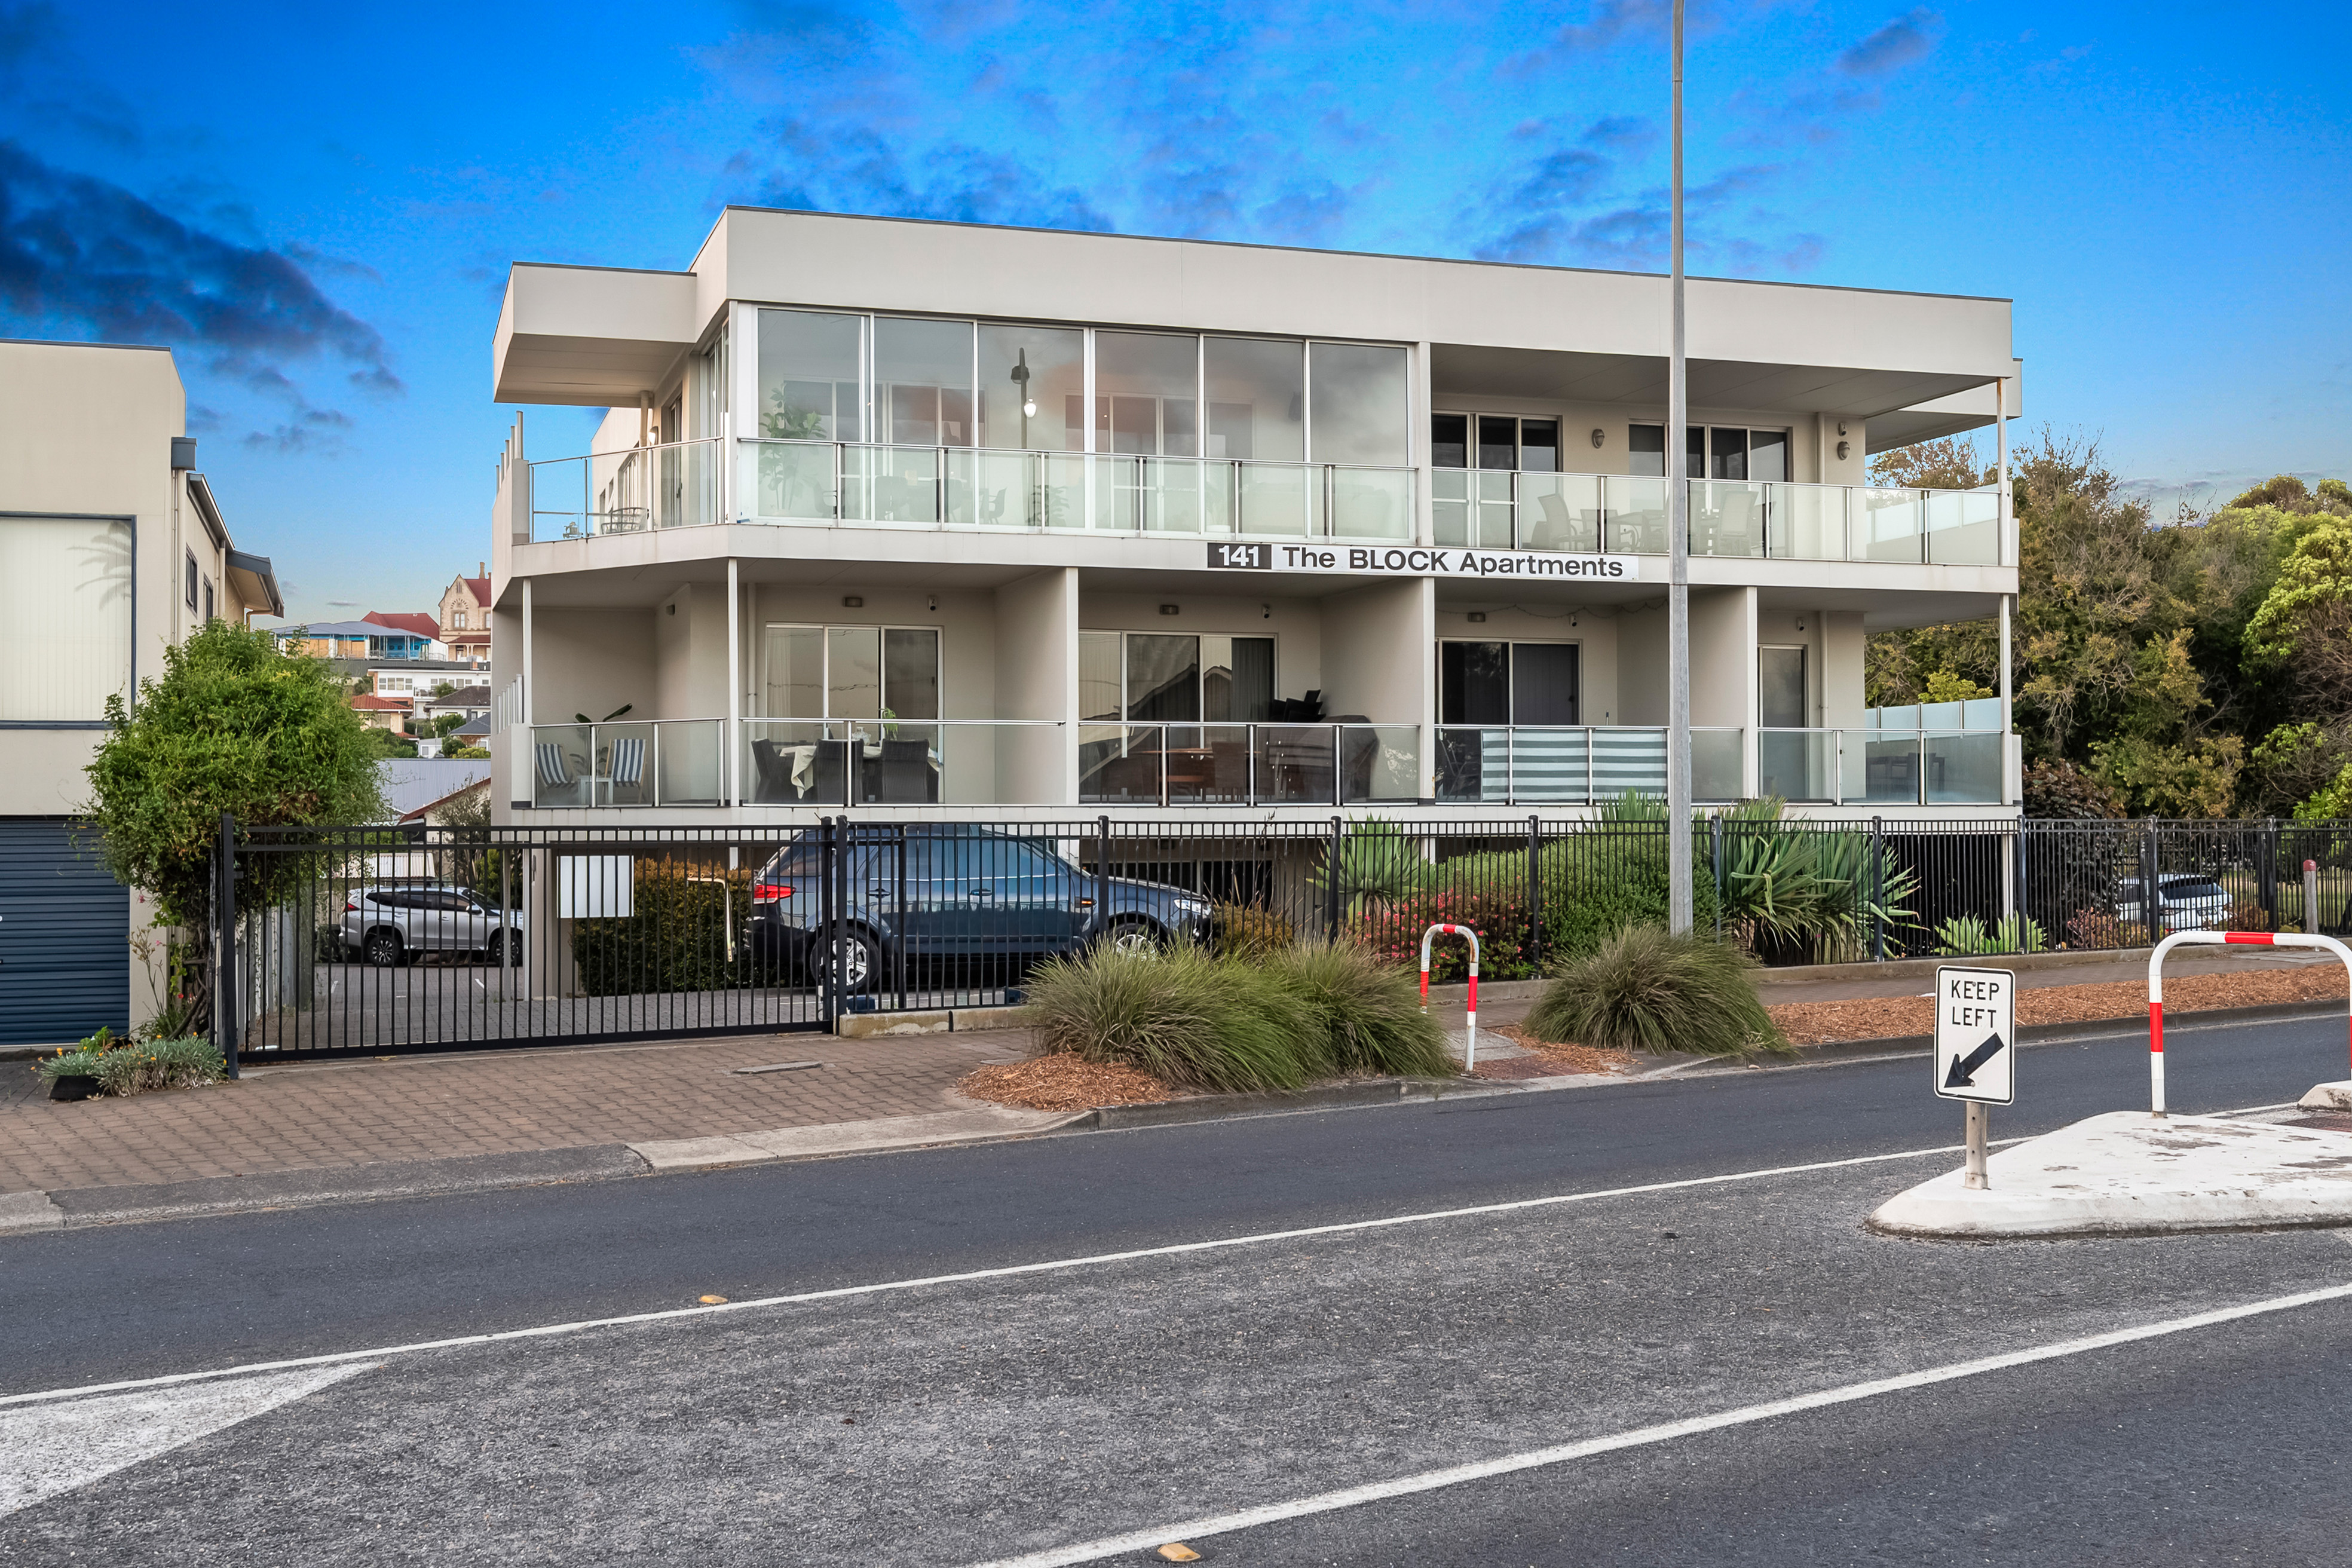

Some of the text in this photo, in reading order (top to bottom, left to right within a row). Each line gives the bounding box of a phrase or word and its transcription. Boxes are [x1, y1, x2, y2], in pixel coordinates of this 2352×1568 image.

[1218, 545, 1623, 576] 141 The BLOCK Apartments
[1951, 980, 1999, 1000] KEEP
[1952, 1006, 1996, 1028] LEFT
